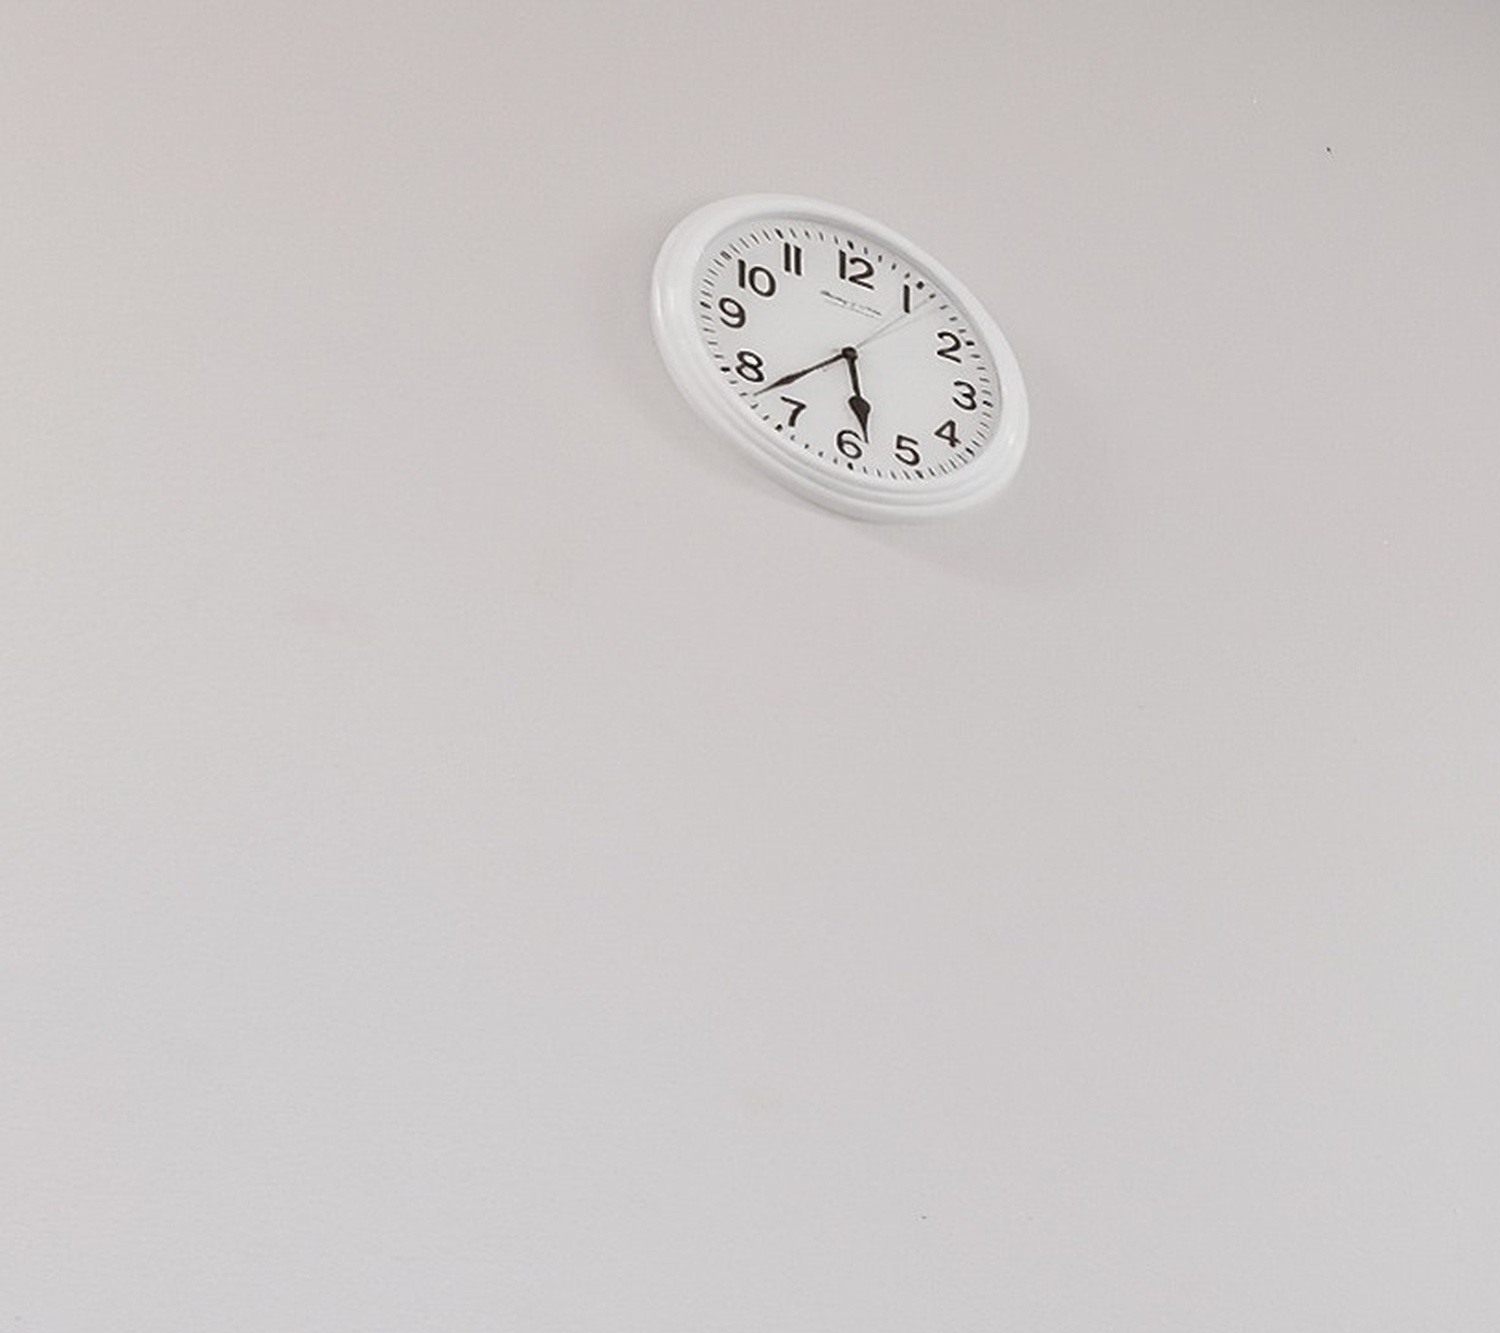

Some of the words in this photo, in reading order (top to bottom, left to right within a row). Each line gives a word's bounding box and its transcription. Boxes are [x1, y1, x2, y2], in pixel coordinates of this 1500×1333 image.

[784, 242, 802, 276] 11
[839, 249, 875, 290] 12
[737, 259, 776, 297] 10
[718, 297, 746, 329] 9
[902, 284, 911, 313] 1
[936, 331, 962, 363] 2
[736, 351, 765, 383] 8
[953, 380, 977, 411] 3
[780, 396, 806, 427] 7
[836, 429, 863, 460] 6
[934, 419, 961, 447] 4
[896, 435, 920, 466] 5
